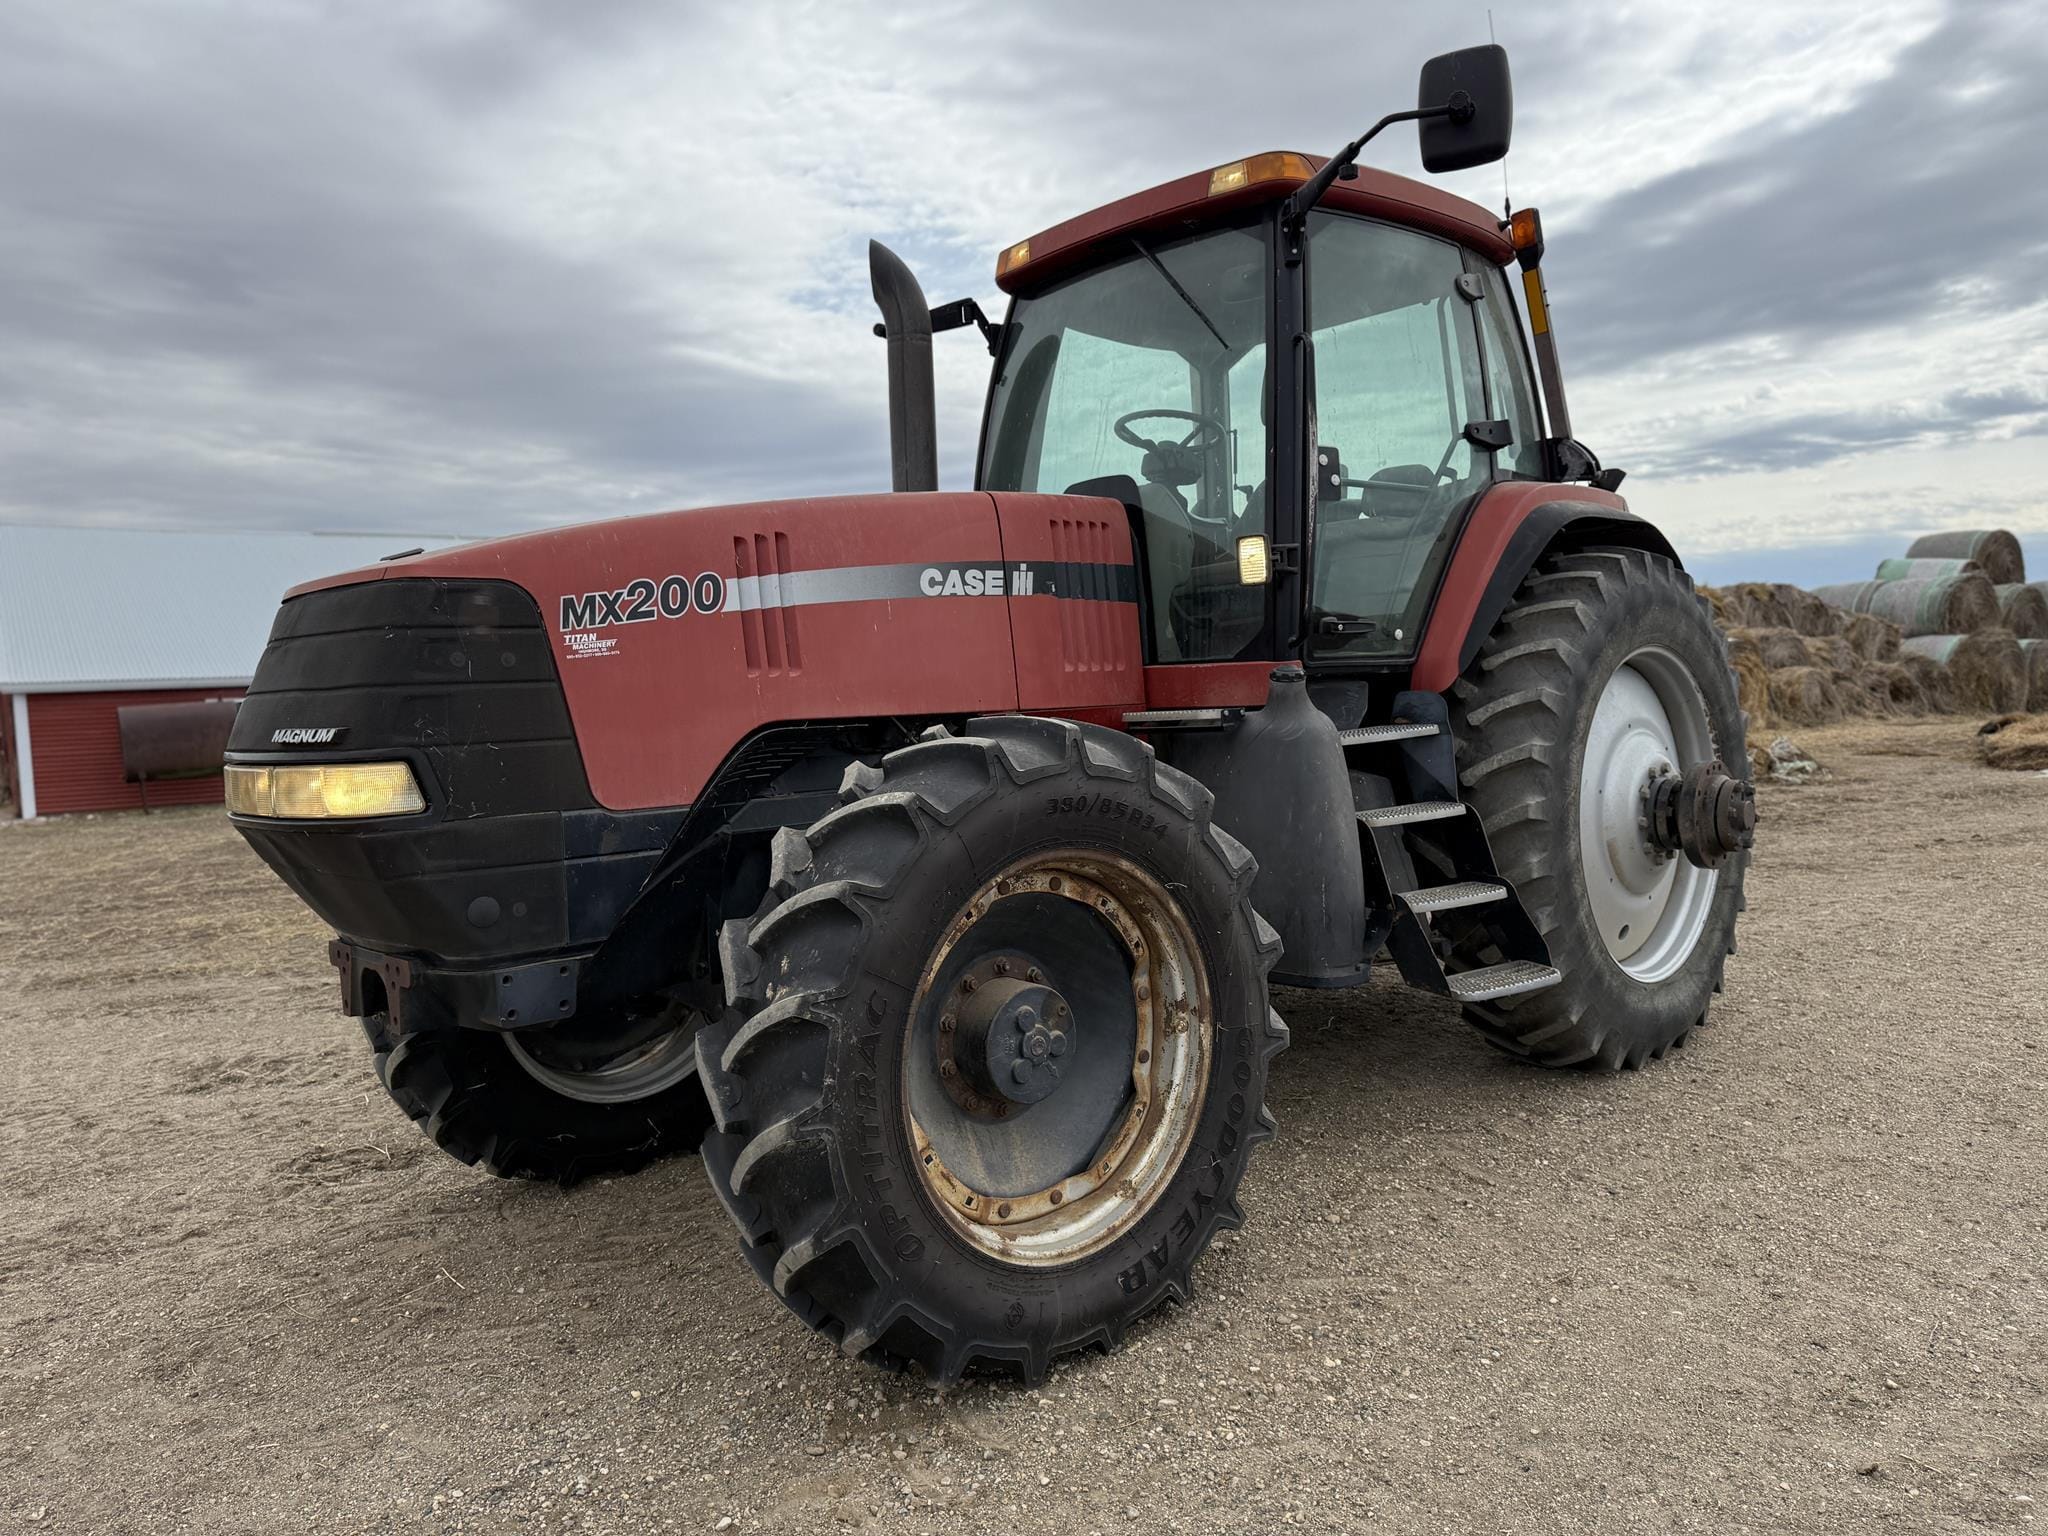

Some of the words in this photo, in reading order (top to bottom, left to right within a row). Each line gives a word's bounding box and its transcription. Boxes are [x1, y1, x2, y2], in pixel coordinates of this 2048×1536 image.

[920, 568, 1004, 596] CASE
[560, 572, 723, 632] MX200
[563, 633, 597, 645] TITAN
[572, 640, 617, 651] MACHINERY
[271, 728, 337, 744] MAGNUM
[855, 989, 925, 1263] OPTITRAC
[1116, 1028, 1253, 1295] GOODYEAR
